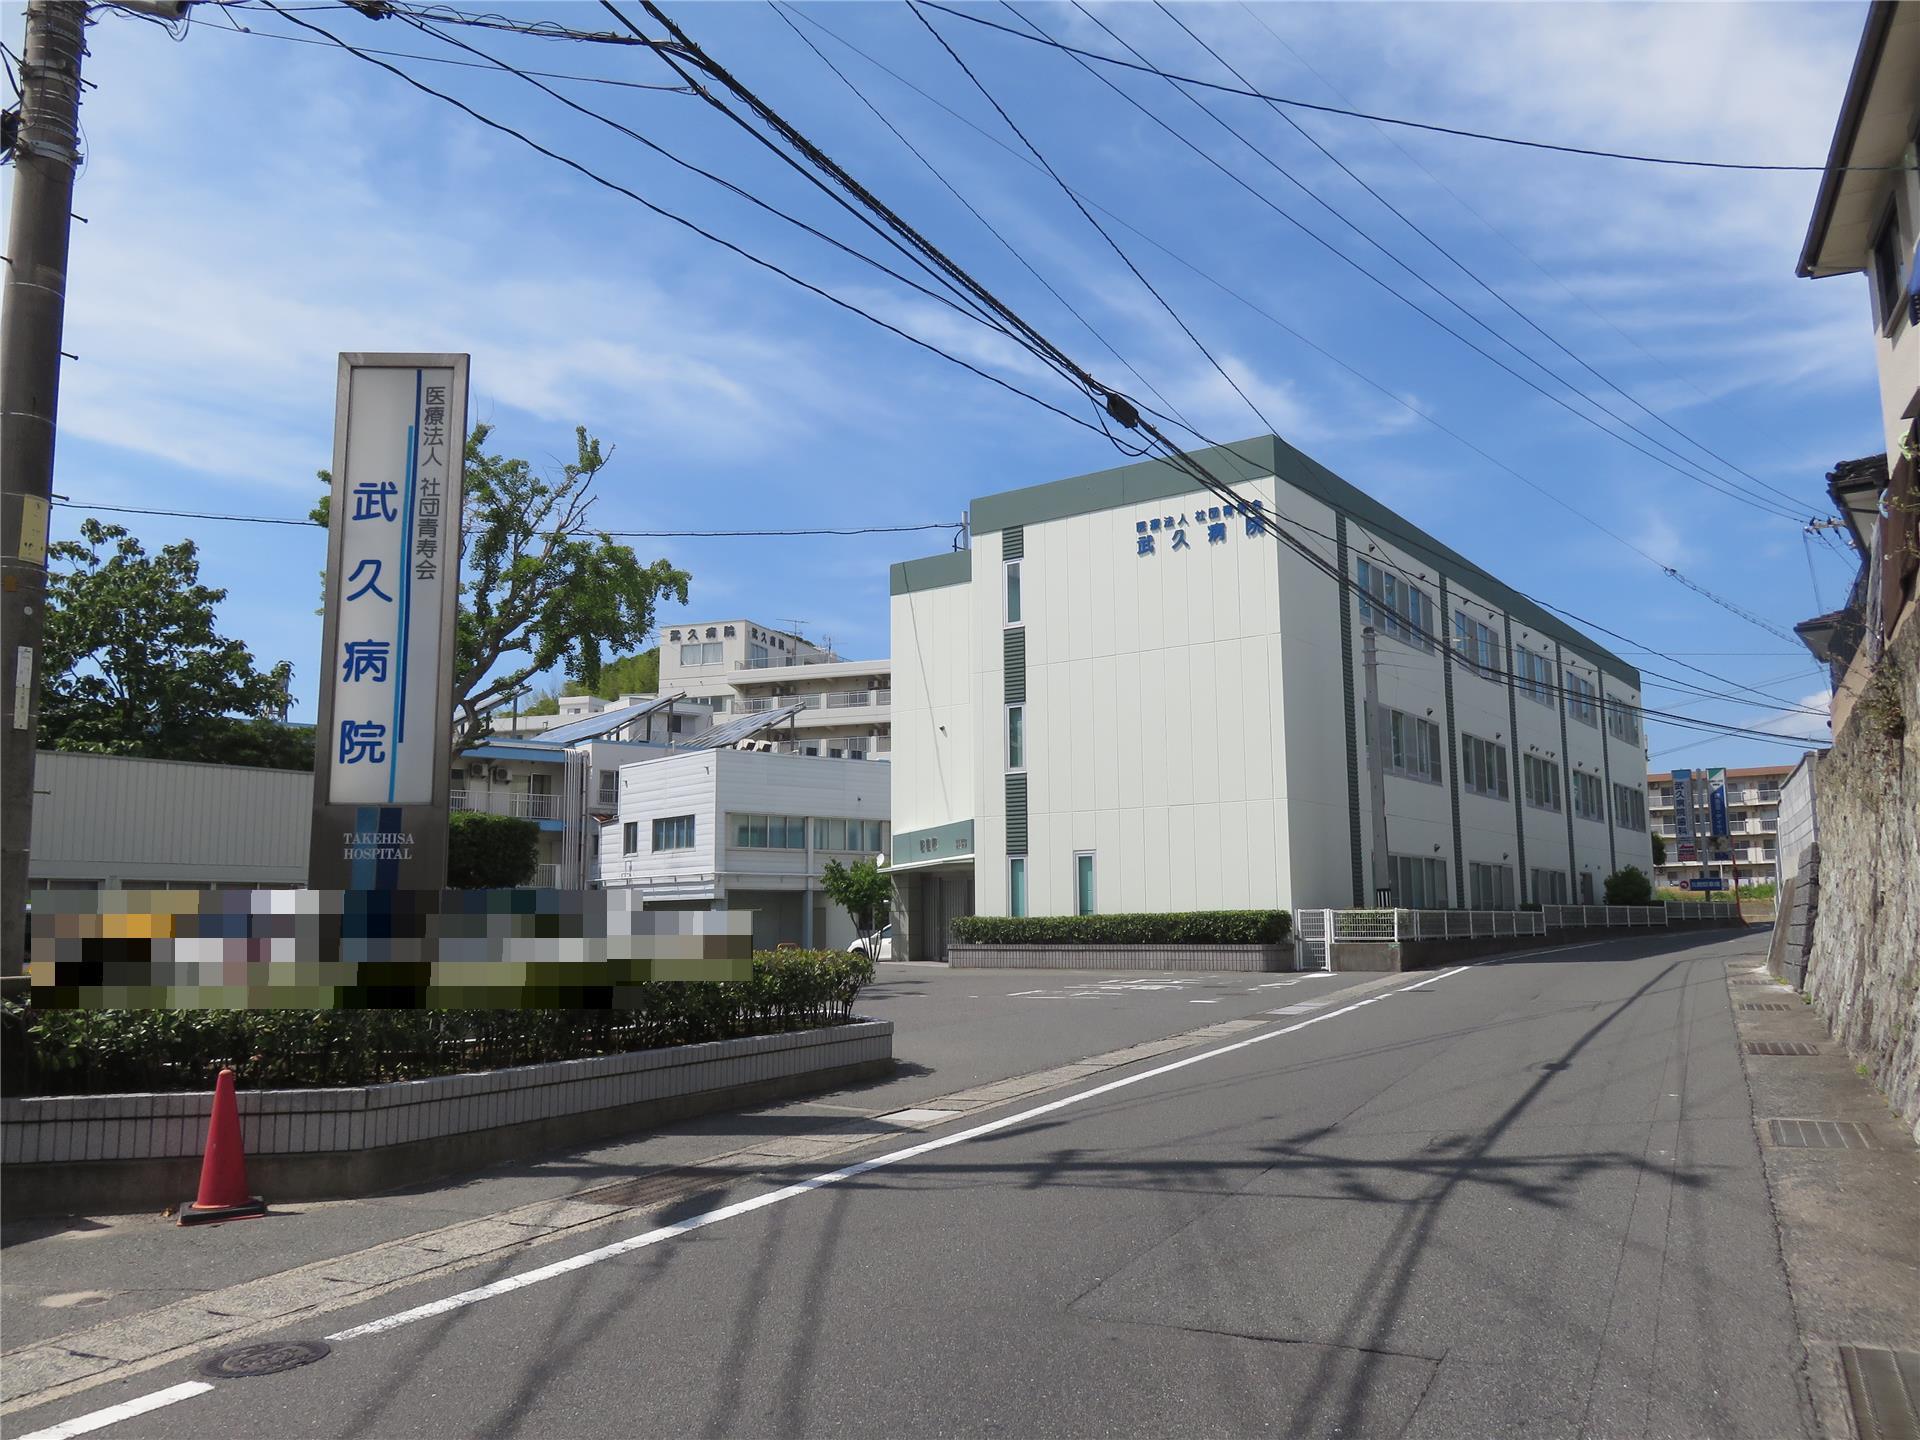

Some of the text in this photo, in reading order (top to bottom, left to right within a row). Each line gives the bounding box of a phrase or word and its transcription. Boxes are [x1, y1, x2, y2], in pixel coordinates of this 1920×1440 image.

[415, 386, 446, 581] 医療法人 社団青寿会
[1135, 513, 1190, 535] 医療法人
[1136, 516, 1266, 557] 武久病院
[339, 481, 398, 764] 武久病院
[669, 624, 737, 642] 武久病院
[751, 627, 785, 651] 武久病院
[343, 832, 415, 845] TAKEHISA
[343, 848, 412, 860] HOSPITAL
